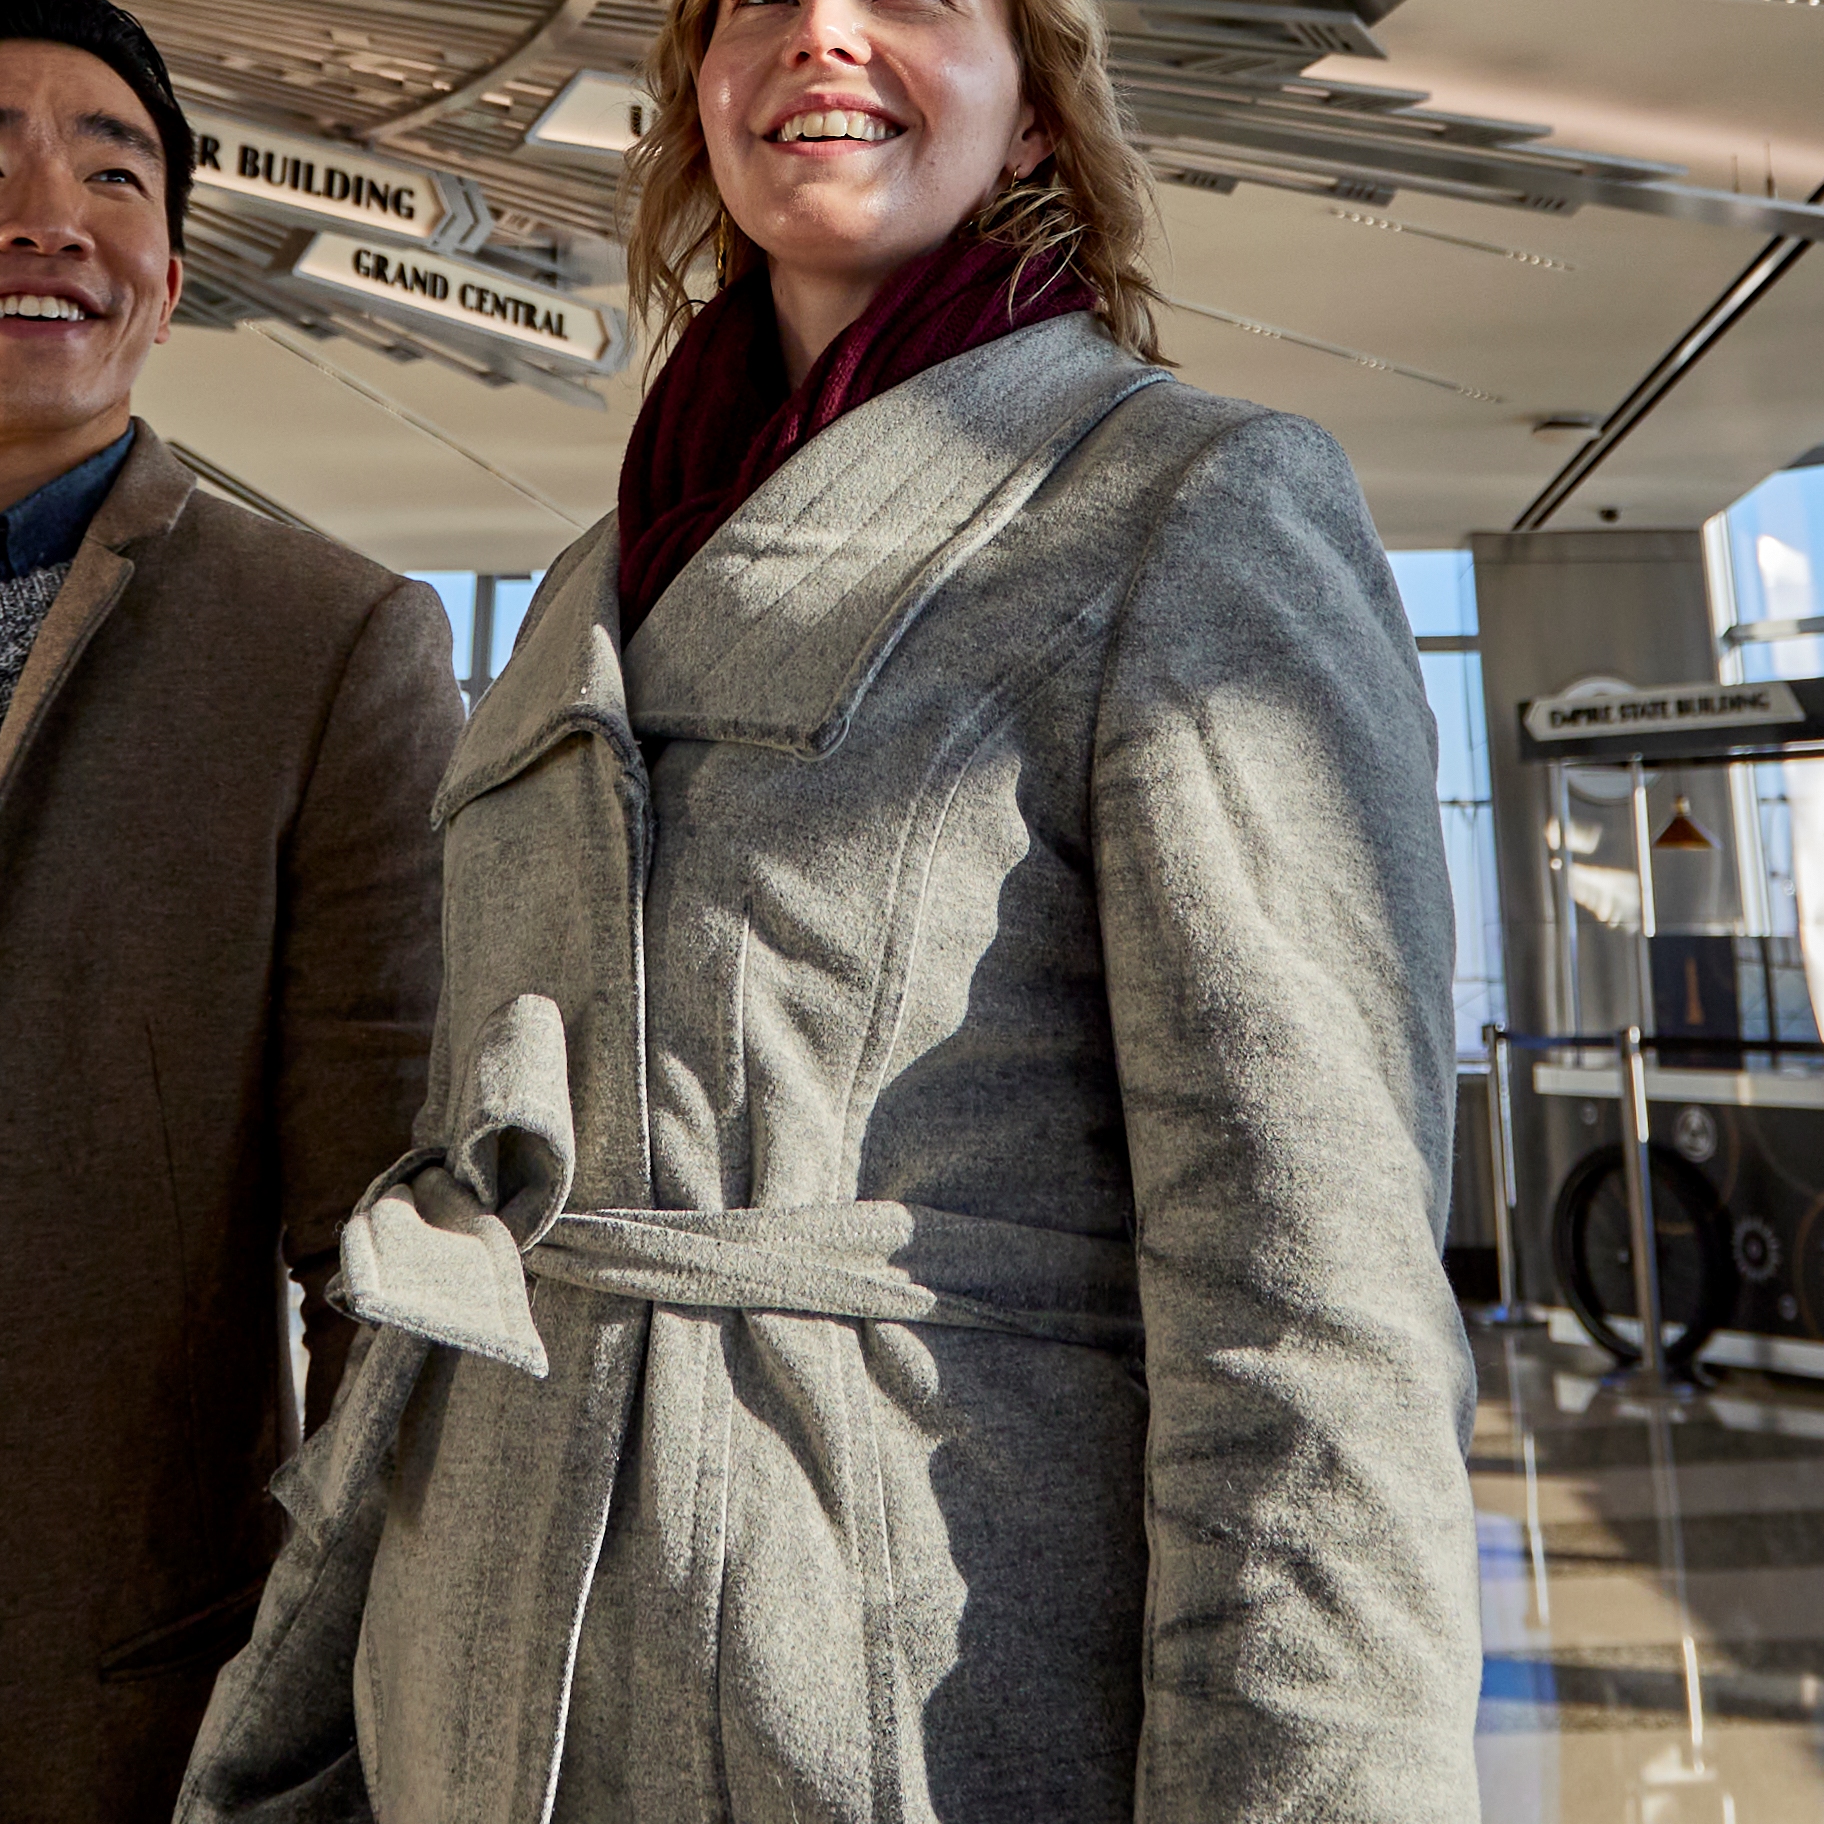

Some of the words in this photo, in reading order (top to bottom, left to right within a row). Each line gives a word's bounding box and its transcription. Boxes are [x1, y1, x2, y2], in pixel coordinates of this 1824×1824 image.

[237, 144, 416, 220] BUILDING
[352, 248, 450, 301] GRAND
[457, 282, 569, 341] CENTRAL
[1550, 704, 1611, 728] EMPIRE
[1619, 699, 1669, 721] STATE
[1676, 691, 1770, 714] BUILDING
